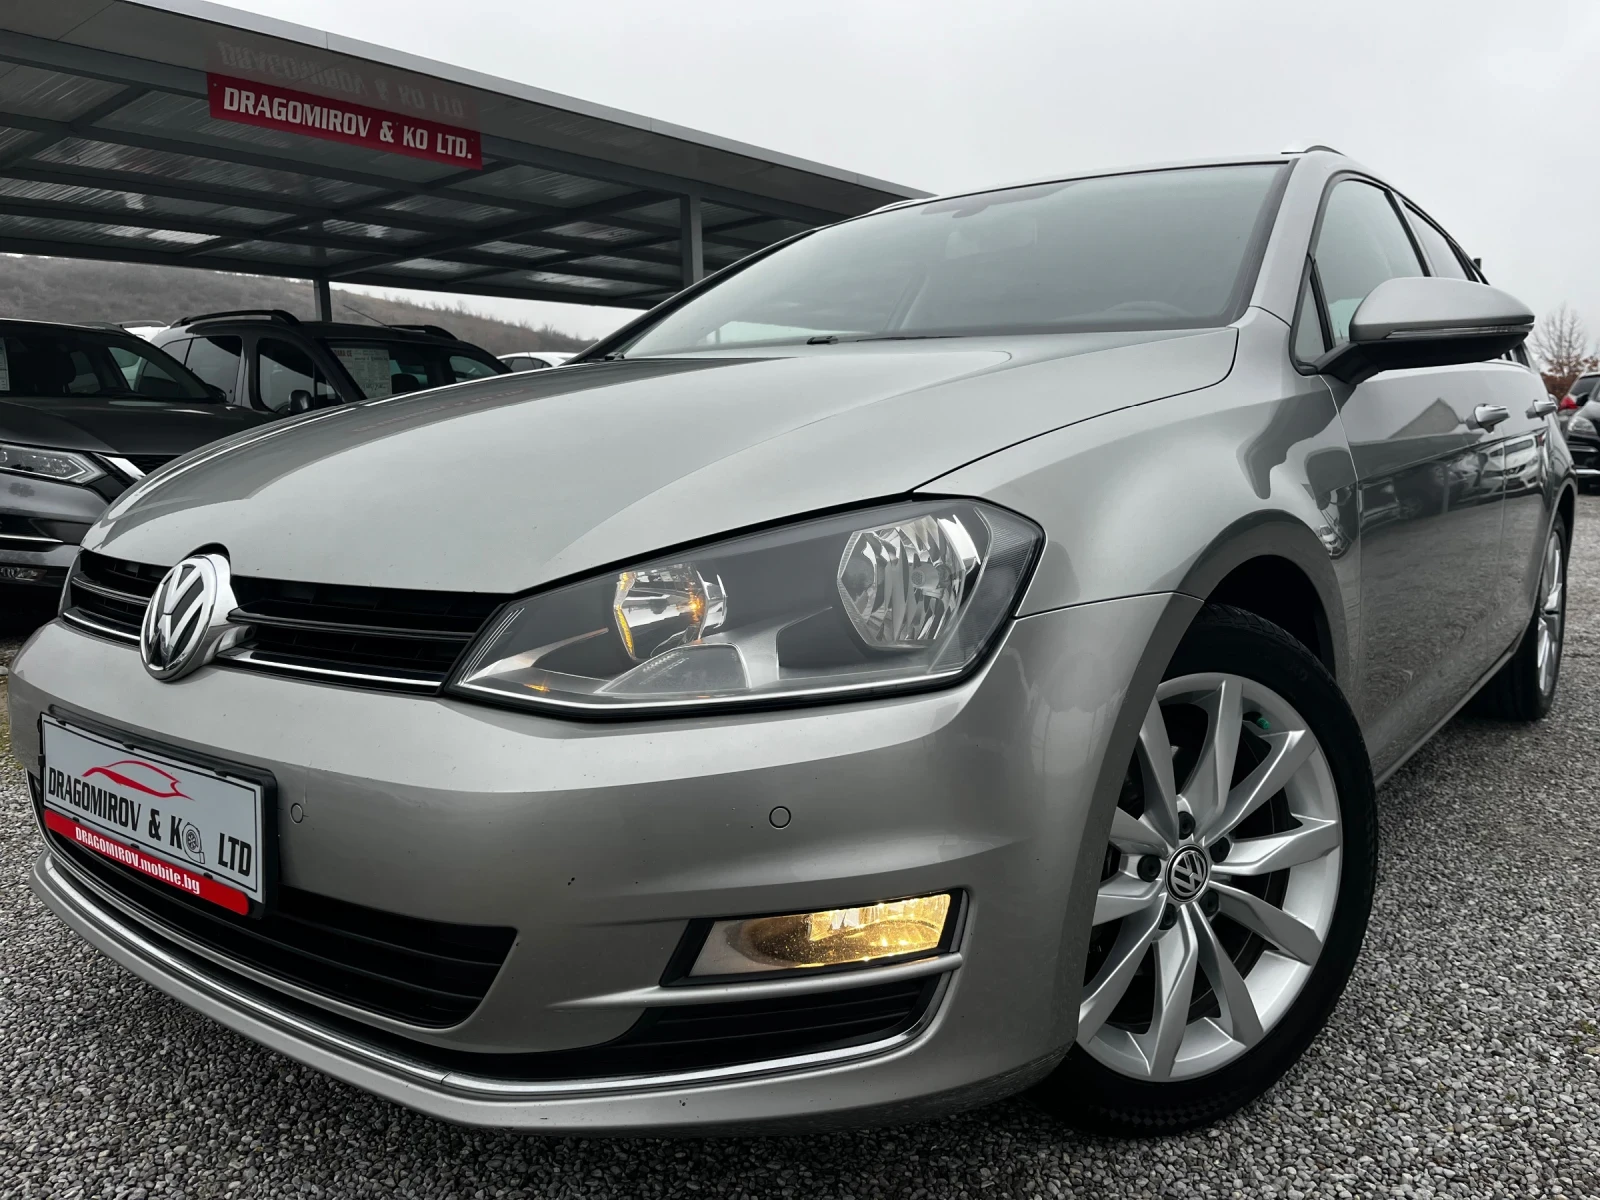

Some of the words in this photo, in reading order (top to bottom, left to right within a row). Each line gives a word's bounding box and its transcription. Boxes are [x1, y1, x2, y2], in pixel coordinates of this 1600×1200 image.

[223, 87, 372, 138] DRAGOMIROV
[379, 120, 395, 143] &
[403, 125, 429, 150] KO
[436, 133, 473, 159] LTD.
[48, 766, 141, 832] DRAGOMIROV
[148, 808, 162, 842] &
[217, 832, 252, 877] LTD
[75, 826, 201, 895] DRAGOMIROV.mobile.bg
